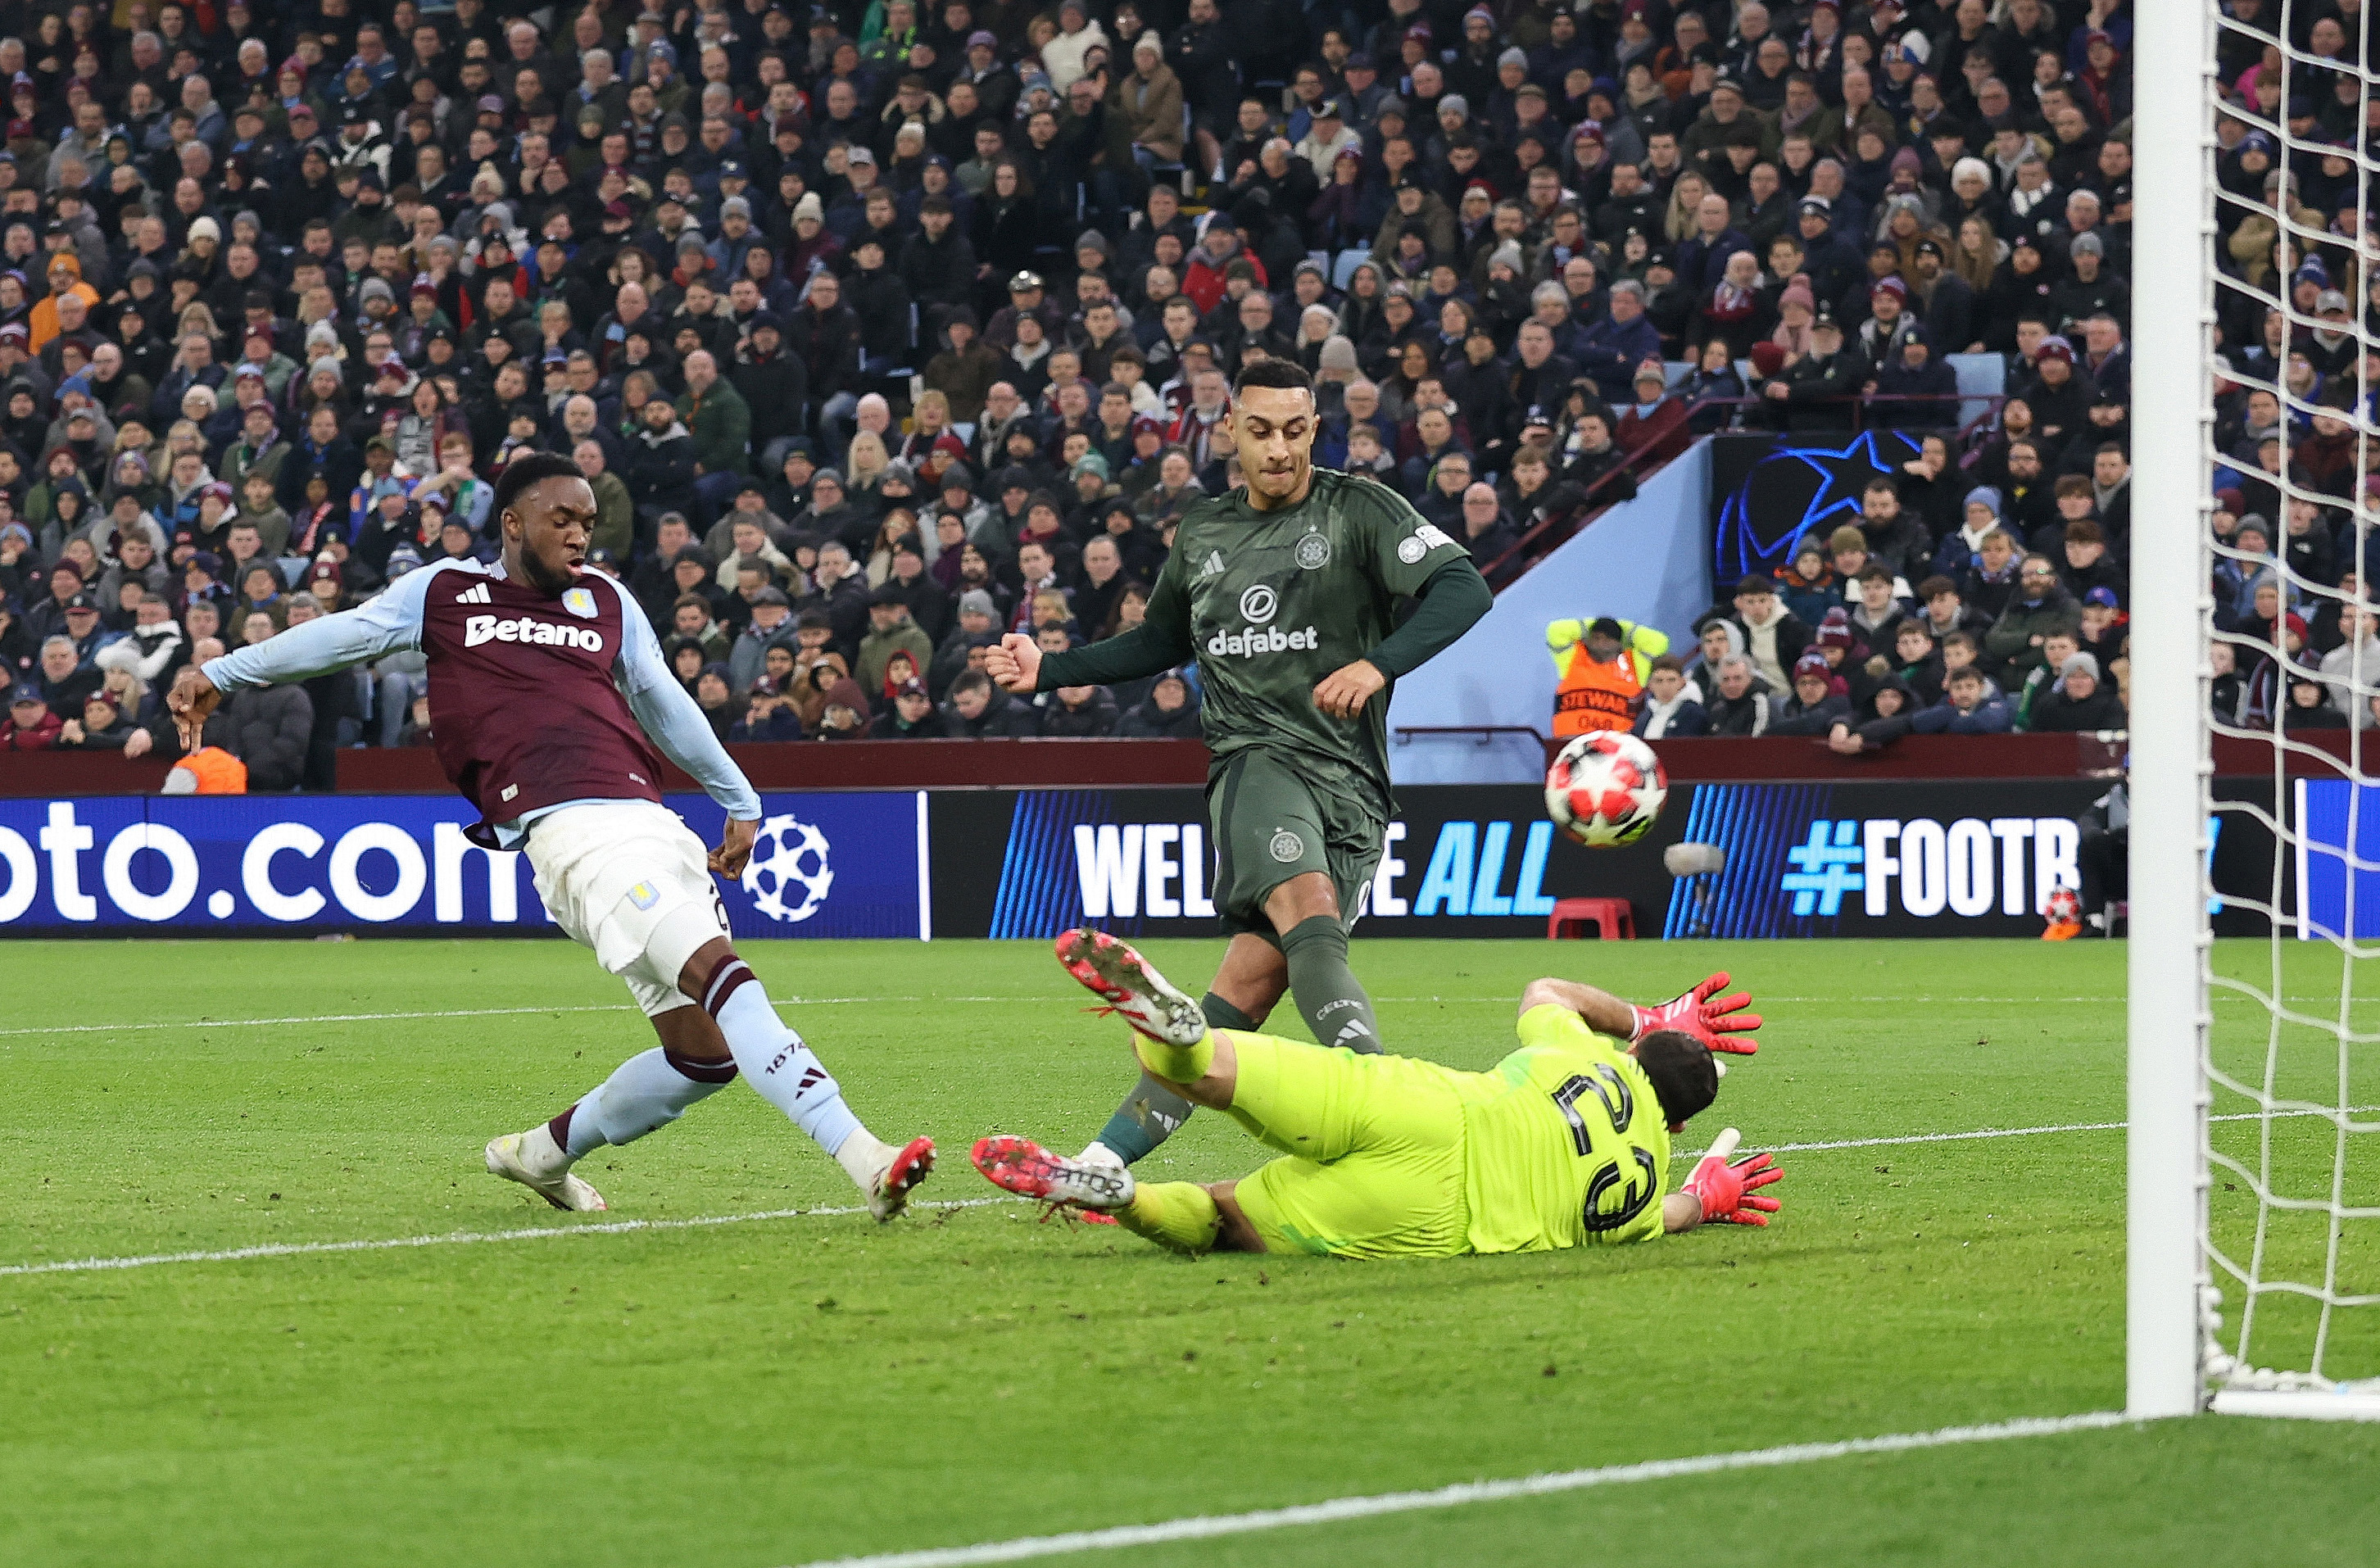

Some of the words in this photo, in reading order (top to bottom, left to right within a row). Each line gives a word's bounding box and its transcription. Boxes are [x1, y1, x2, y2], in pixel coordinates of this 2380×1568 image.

[465, 614, 604, 653] Betano
[1208, 625, 1318, 659] dafabet
[1412, 820, 1556, 918] ALL
[1550, 1062, 1658, 1232] 23
